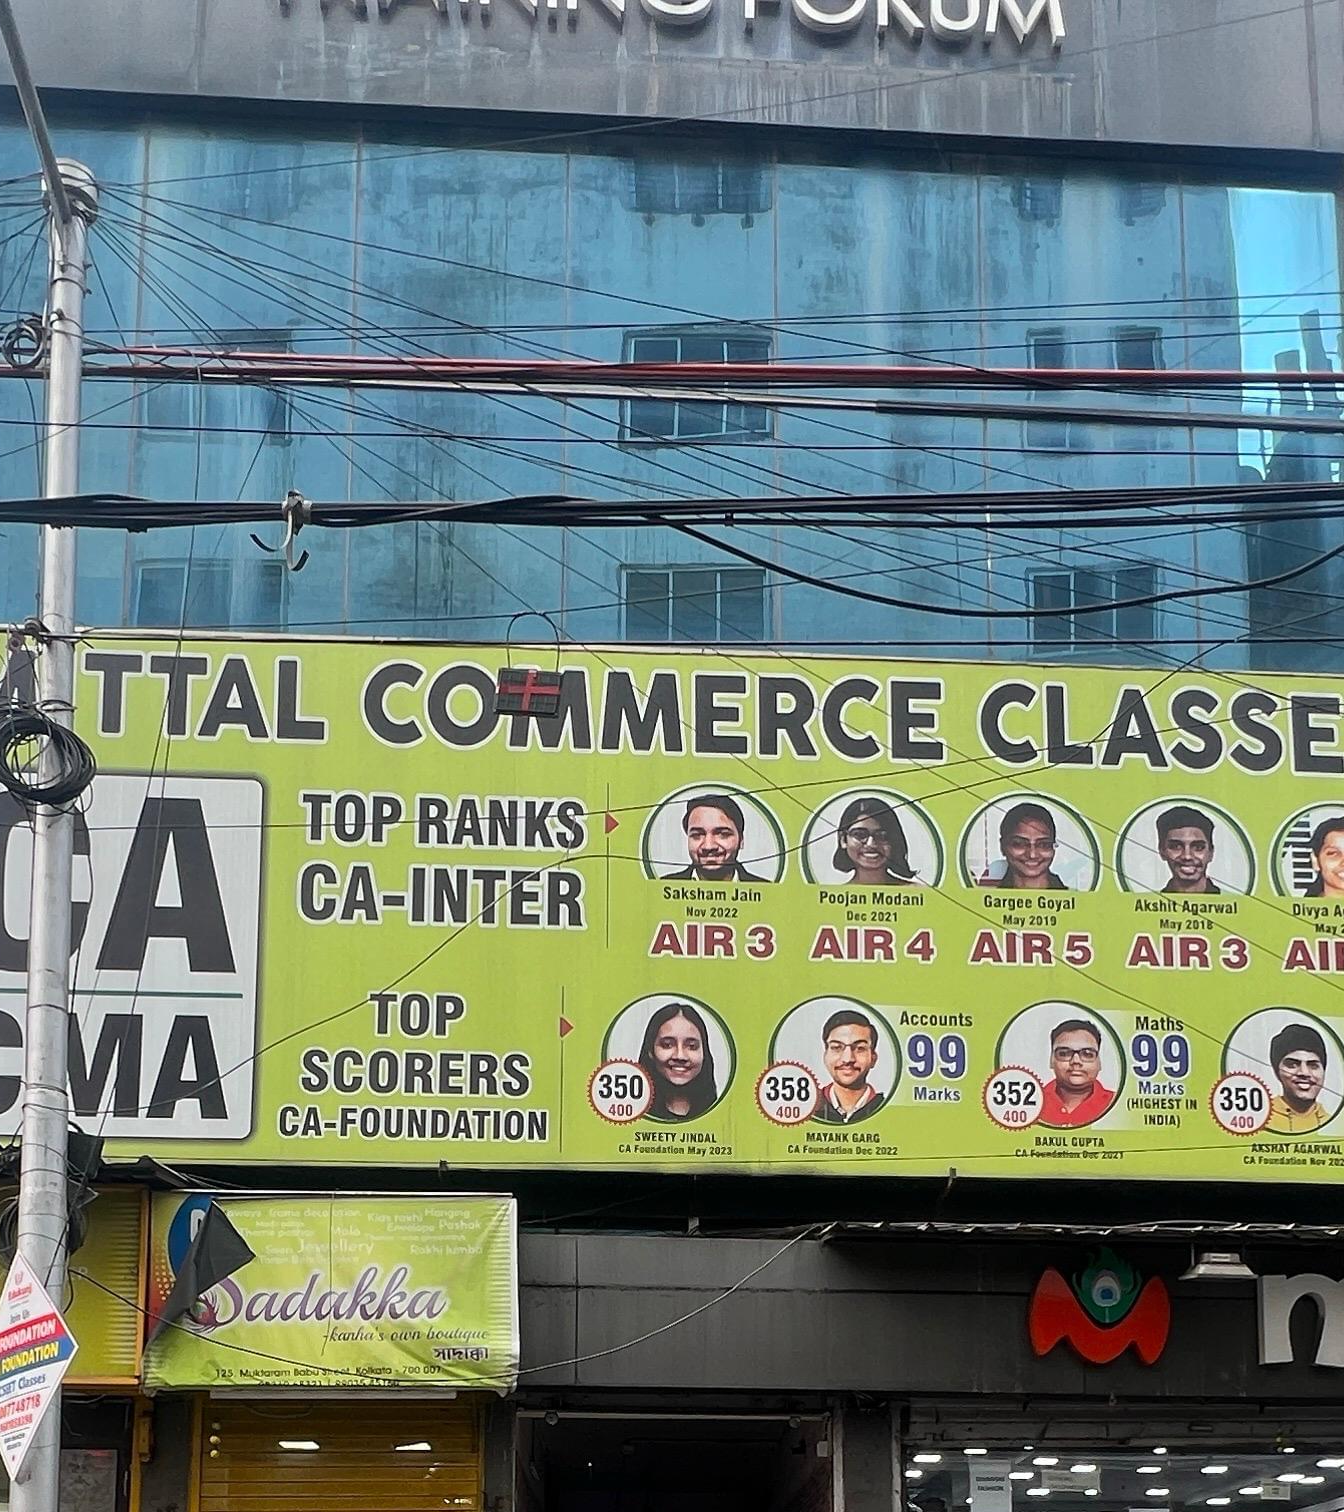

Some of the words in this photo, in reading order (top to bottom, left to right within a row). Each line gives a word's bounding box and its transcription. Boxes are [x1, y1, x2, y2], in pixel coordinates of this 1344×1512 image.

[364, 661, 945, 761] COMMERCE
[303, 793, 403, 842] TOP
[418, 796, 586, 848] RANKS
[300, 863, 586, 927] CA-INTER
[663, 886, 727, 903] Saksham
[731, 887, 762, 903] Jain
[819, 891, 868, 908] Poojan
[872, 891, 924, 907] Modani
[984, 895, 1033, 911] Gargee
[1036, 896, 1076, 912] Goyal
[1134, 898, 1178, 914] Akshit
[1182, 899, 1238, 917] Agarwal
[1292, 903, 1330, 920] Divya
[686, 907, 707, 919] Nov
[710, 907, 739, 919] 2022
[846, 911, 867, 923] Dec
[869, 911, 898, 923] 2021
[1003, 914, 1027, 928] May
[1030, 914, 1057, 927] 2019
[1159, 918, 1184, 932] May
[1315, 922, 1339, 936] May
[651, 924, 735, 958] AIR
[747, 927, 776, 958] 3
[811, 927, 895, 961] AIR
[906, 931, 935, 962] 4
[970, 931, 1055, 965] AIR
[1064, 934, 1093, 966] 5
[1127, 935, 1210, 969] AIR
[1221, 938, 1249, 968] 3
[368, 993, 464, 1037] TOP
[899, 1010, 973, 1028] Accounts
[1134, 1015, 1184, 1032] Maths
[907, 1034, 966, 1079] 99
[1131, 1033, 1190, 1078] 99
[301, 1049, 530, 1098] SCORERS
[598, 1073, 644, 1101] 350
[765, 1076, 810, 1104] 358
[913, 1086, 961, 1103] Marks
[992, 1079, 1037, 1107] 352
[1138, 1080, 1184, 1096] Marks
[1126, 1097, 1181, 1112] (HIGHEST
[1185, 1098, 1198, 1110] IN
[1218, 1086, 1263, 1113] 350
[608, 1103, 634, 1118] 400
[775, 1105, 800, 1119] 400
[1003, 1109, 1027, 1124] 400
[278, 1106, 548, 1142] CA-FOUNDATION
[1143, 1113, 1181, 1128] INDIA)
[1230, 1114, 1255, 1129] 400
[634, 1132, 677, 1143] SWEETY
[679, 1132, 717, 1143] JINDAL
[806, 1132, 849, 1144] MAYANK
[852, 1133, 881, 1144] GARG
[1071, 1137, 1105, 1148] GUPTA
[619, 1144, 631, 1154] CA
[634, 1145, 685, 1155] Foundation
[687, 1145, 707, 1157] May
[788, 1145, 800, 1155] CA
[803, 1145, 853, 1156] Foundation
[855, 1147, 872, 1156] Dec
[875, 1147, 898, 1157] 2022
[1015, 1148, 1029, 1159] CA
[1293, 1144, 1343, 1155] AGARWAL
[1243, 1155, 1256, 1165] CA
[1258, 1156, 1307, 1166] Foundation
[0, 1318, 56, 1352] FOUNDATION
[390, 1331, 421, 1342] own
[425, 1326, 490, 1344] boutique
[0, 1341, 59, 1375] FOUNDATION
